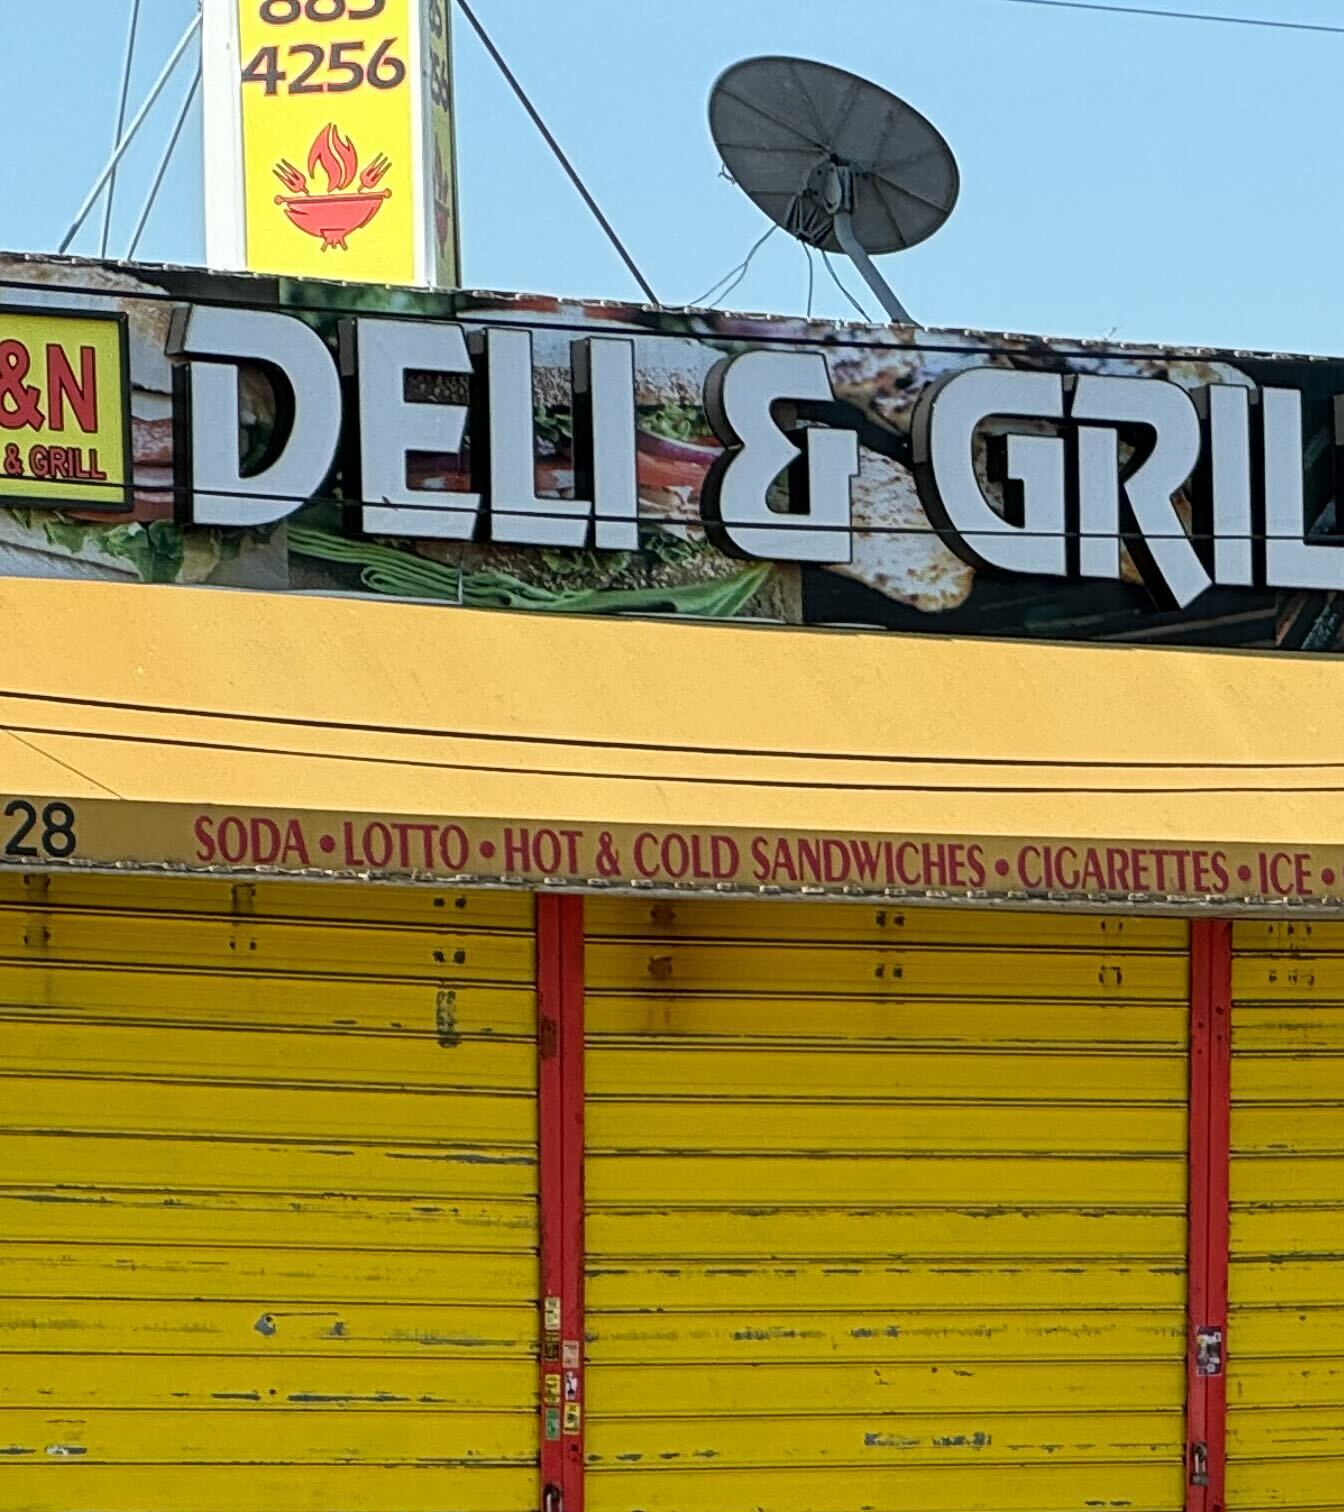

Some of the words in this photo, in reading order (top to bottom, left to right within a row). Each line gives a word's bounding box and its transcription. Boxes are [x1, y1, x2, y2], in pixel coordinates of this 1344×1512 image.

[241, 37, 405, 96] 4256
[4, 443, 23, 476] &
[29, 444, 107, 480] GRILL
[176, 304, 640, 552] DELI
[706, 349, 861, 564] &
[4, 800, 76, 857] 28
[194, 815, 310, 865] SODA
[343, 821, 469, 871] LOTTO
[504, 827, 583, 876] HOT
[595, 831, 621, 877] &
[633, 832, 740, 879] COLD
[751, 836, 987, 889] SANDWICHES
[1017, 845, 1230, 893] CIGARETTES
[1258, 852, 1312, 896] ICE
